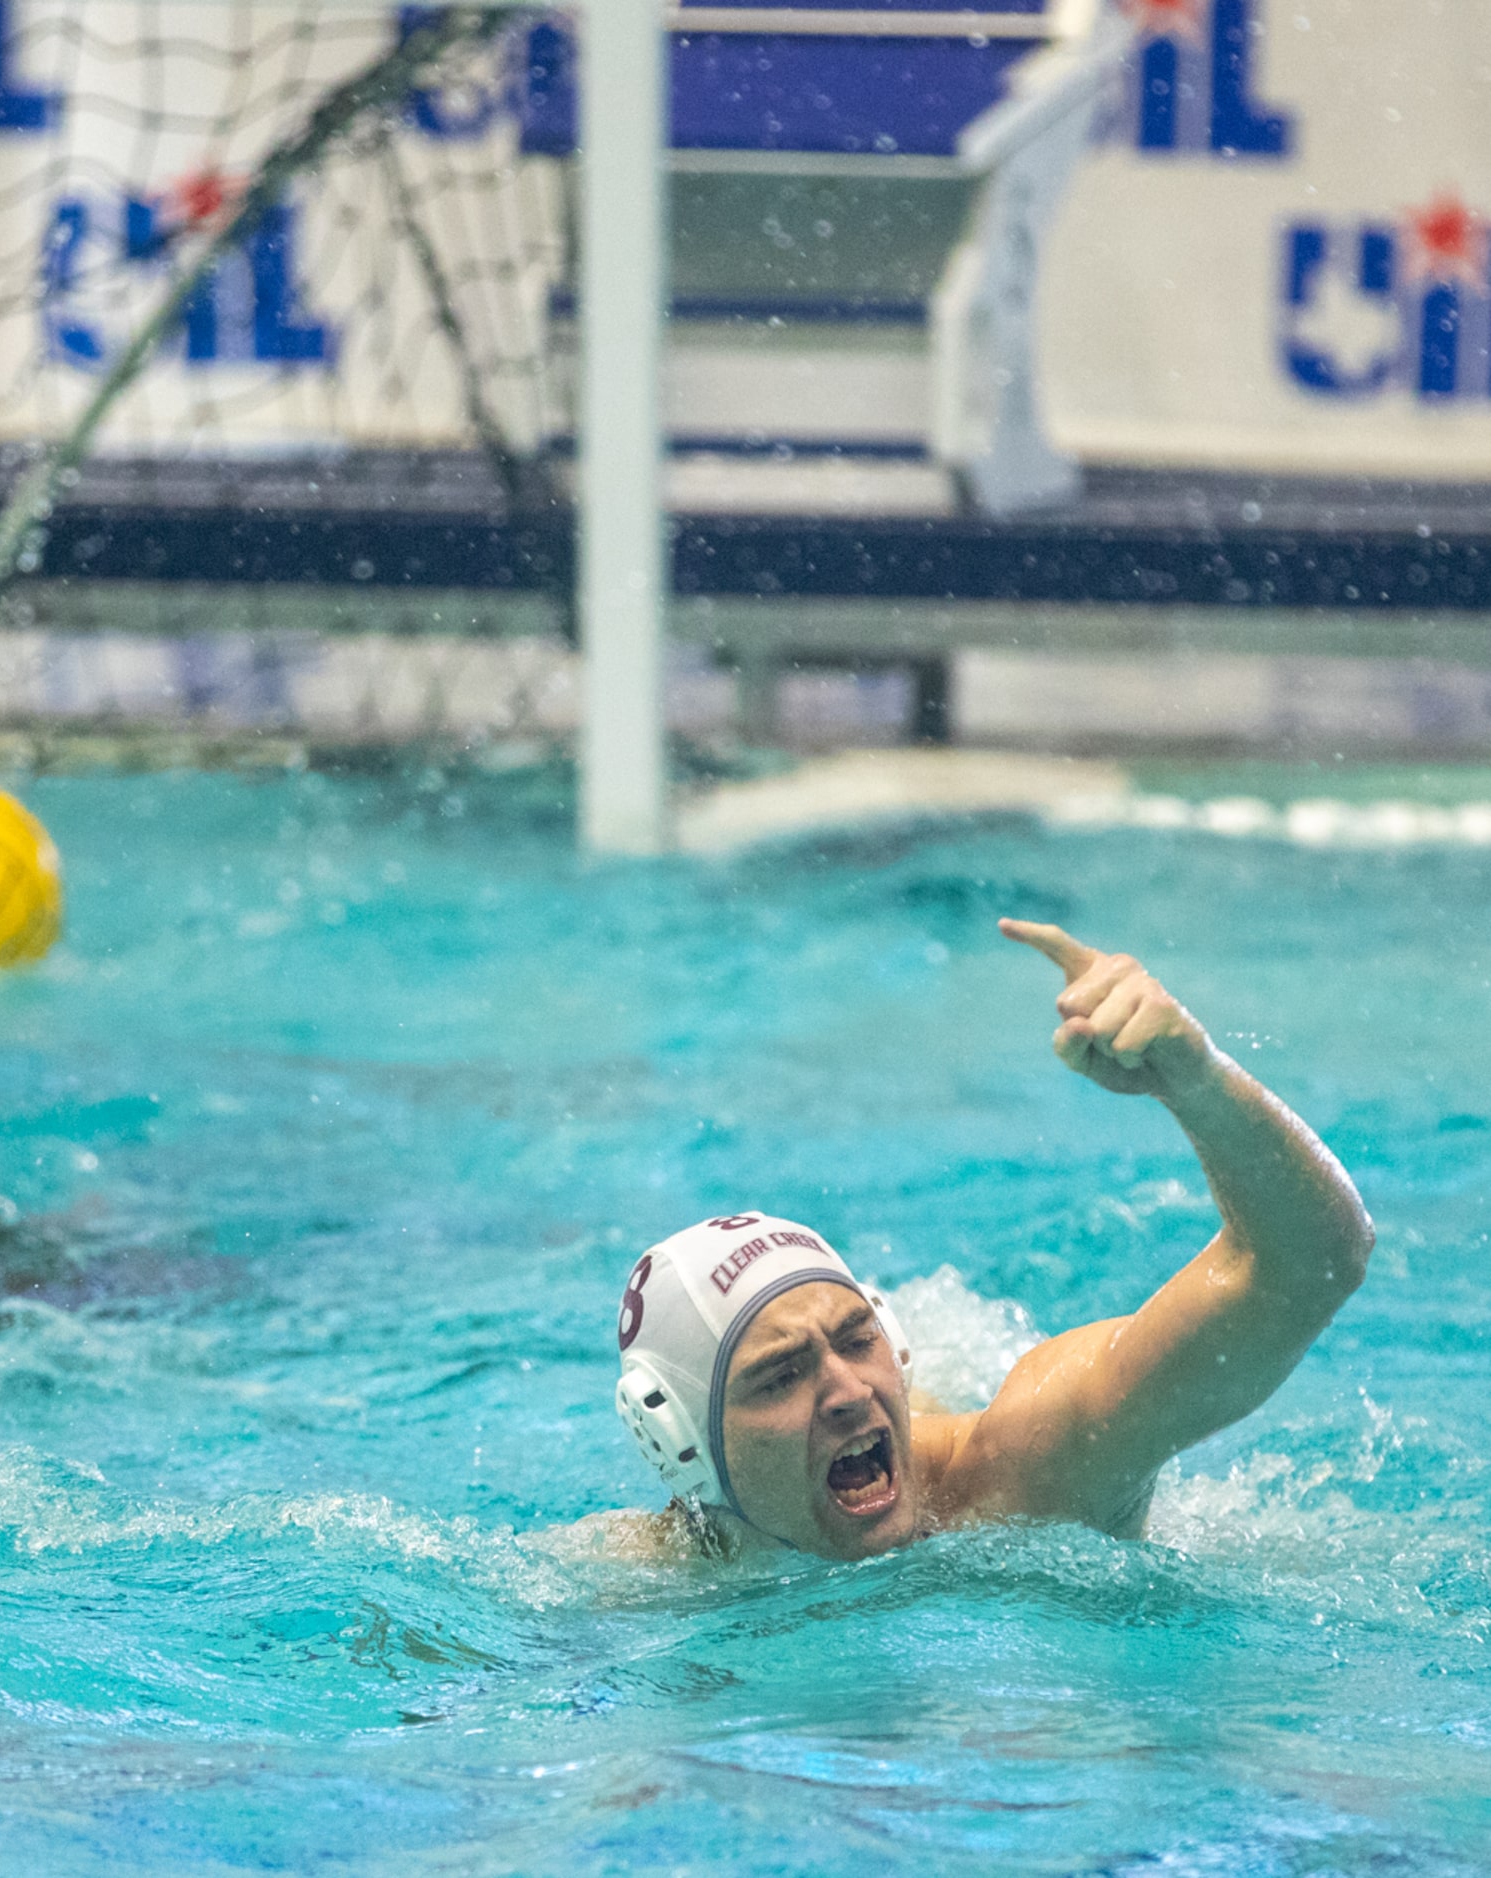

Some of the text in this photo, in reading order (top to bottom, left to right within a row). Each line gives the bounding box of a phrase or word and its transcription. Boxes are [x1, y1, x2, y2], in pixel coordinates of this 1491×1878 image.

[1280, 212, 1491, 396] UI
[618, 1254, 652, 1352] 8
[710, 1238, 771, 1296] CLEAR
